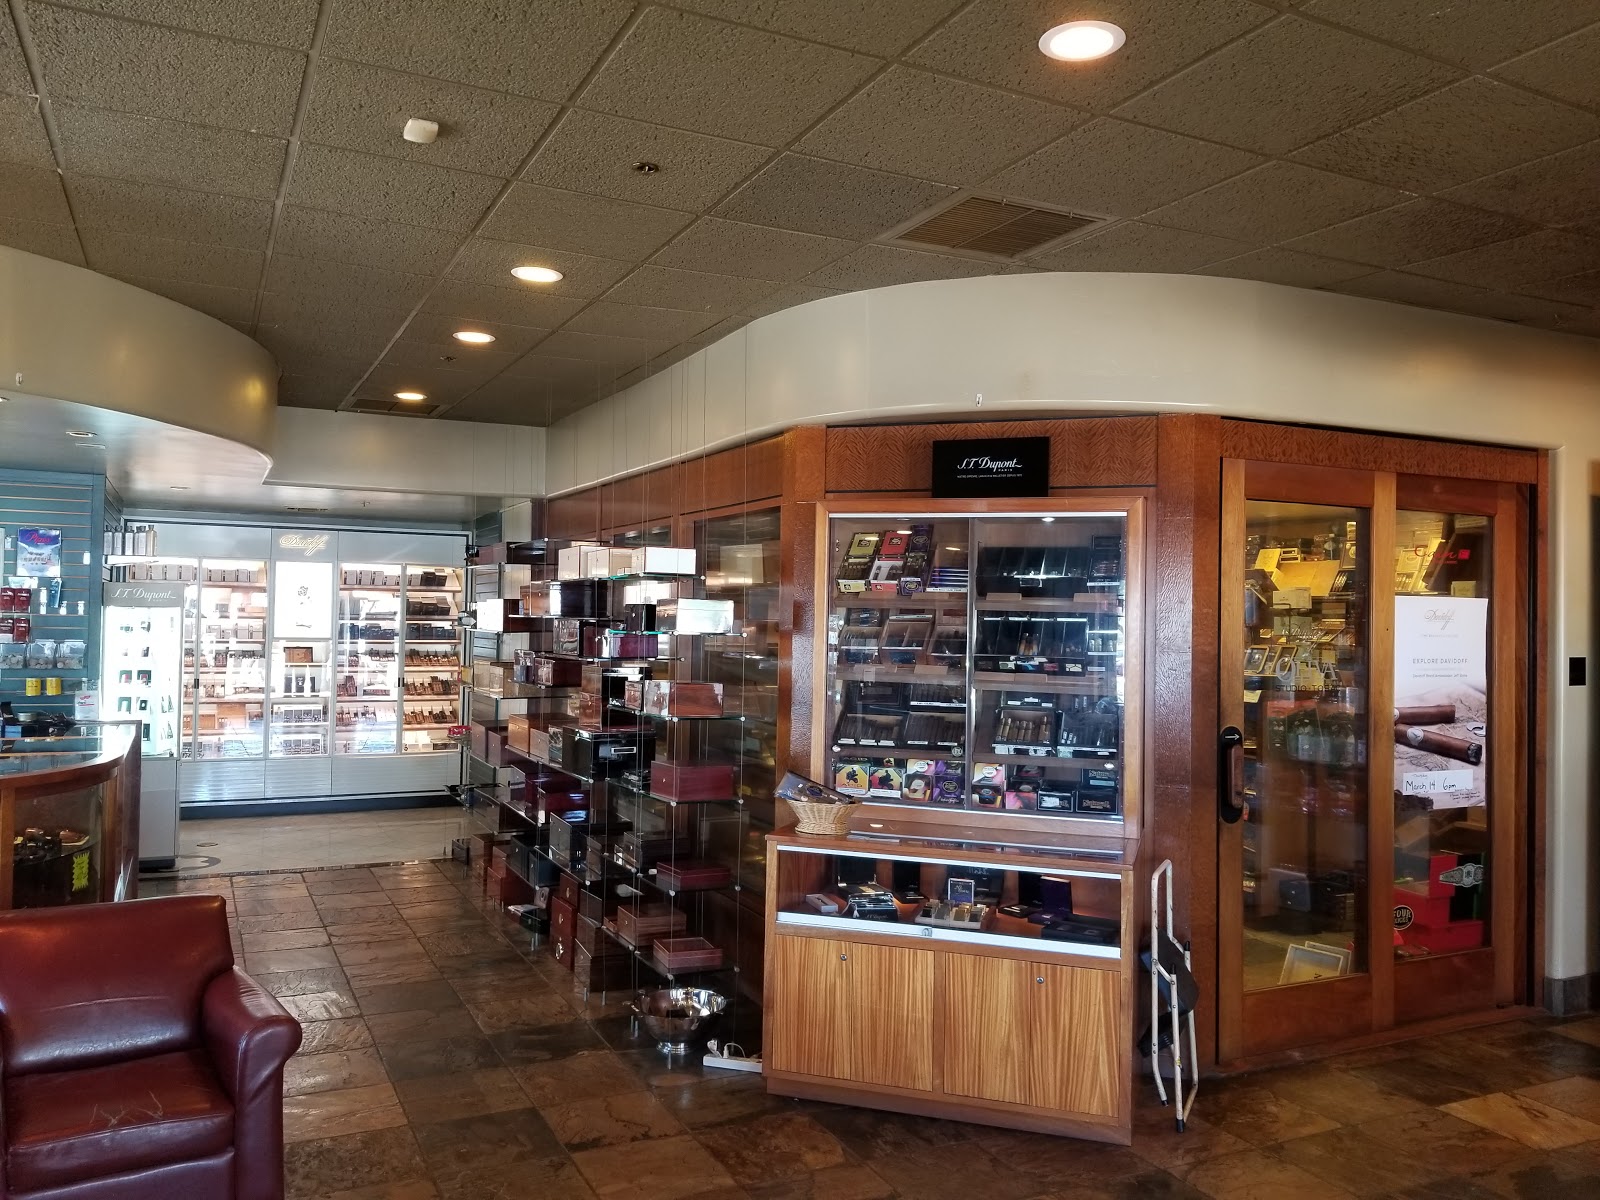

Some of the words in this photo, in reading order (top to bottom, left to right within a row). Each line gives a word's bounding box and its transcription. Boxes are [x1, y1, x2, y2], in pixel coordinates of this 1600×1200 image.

[979, 456, 1023, 472] Dupont
[279, 534, 331, 556] Davidoff
[133, 587, 177, 602] Dupont
[1275, 657, 1338, 682] OLIVA
[1275, 684, 1307, 692] STUDIO
[1405, 780, 1426, 791] March
[1429, 780, 1436, 790] 14
[1443, 777, 1457, 791] 6pm
